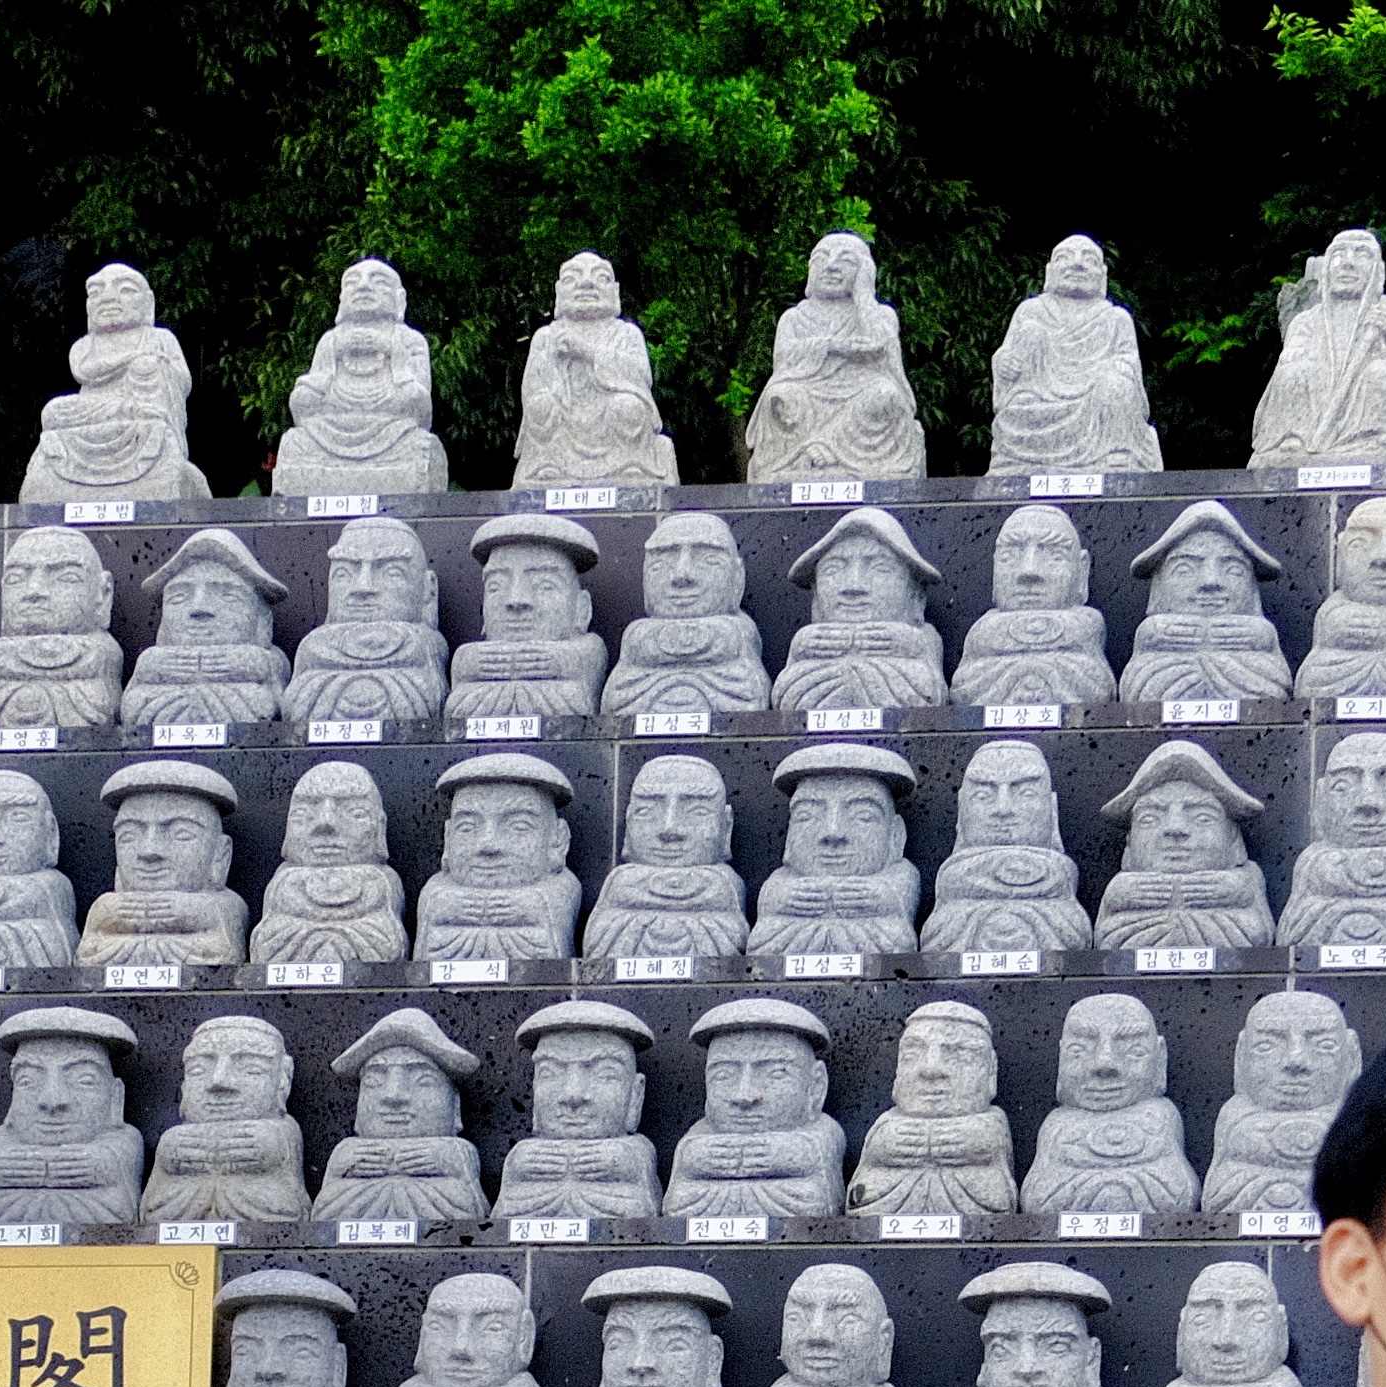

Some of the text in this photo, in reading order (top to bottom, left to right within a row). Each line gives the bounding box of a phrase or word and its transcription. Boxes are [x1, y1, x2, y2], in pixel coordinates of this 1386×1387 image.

[163, 1224, 230, 1242] 고지연
[344, 1223, 411, 1242] 김복례
[514, 1220, 583, 1239] 정만교
[694, 1219, 761, 1237] 전인숙
[885, 1218, 957, 1236] 오수자
[1066, 1216, 1136, 1234] 우정희
